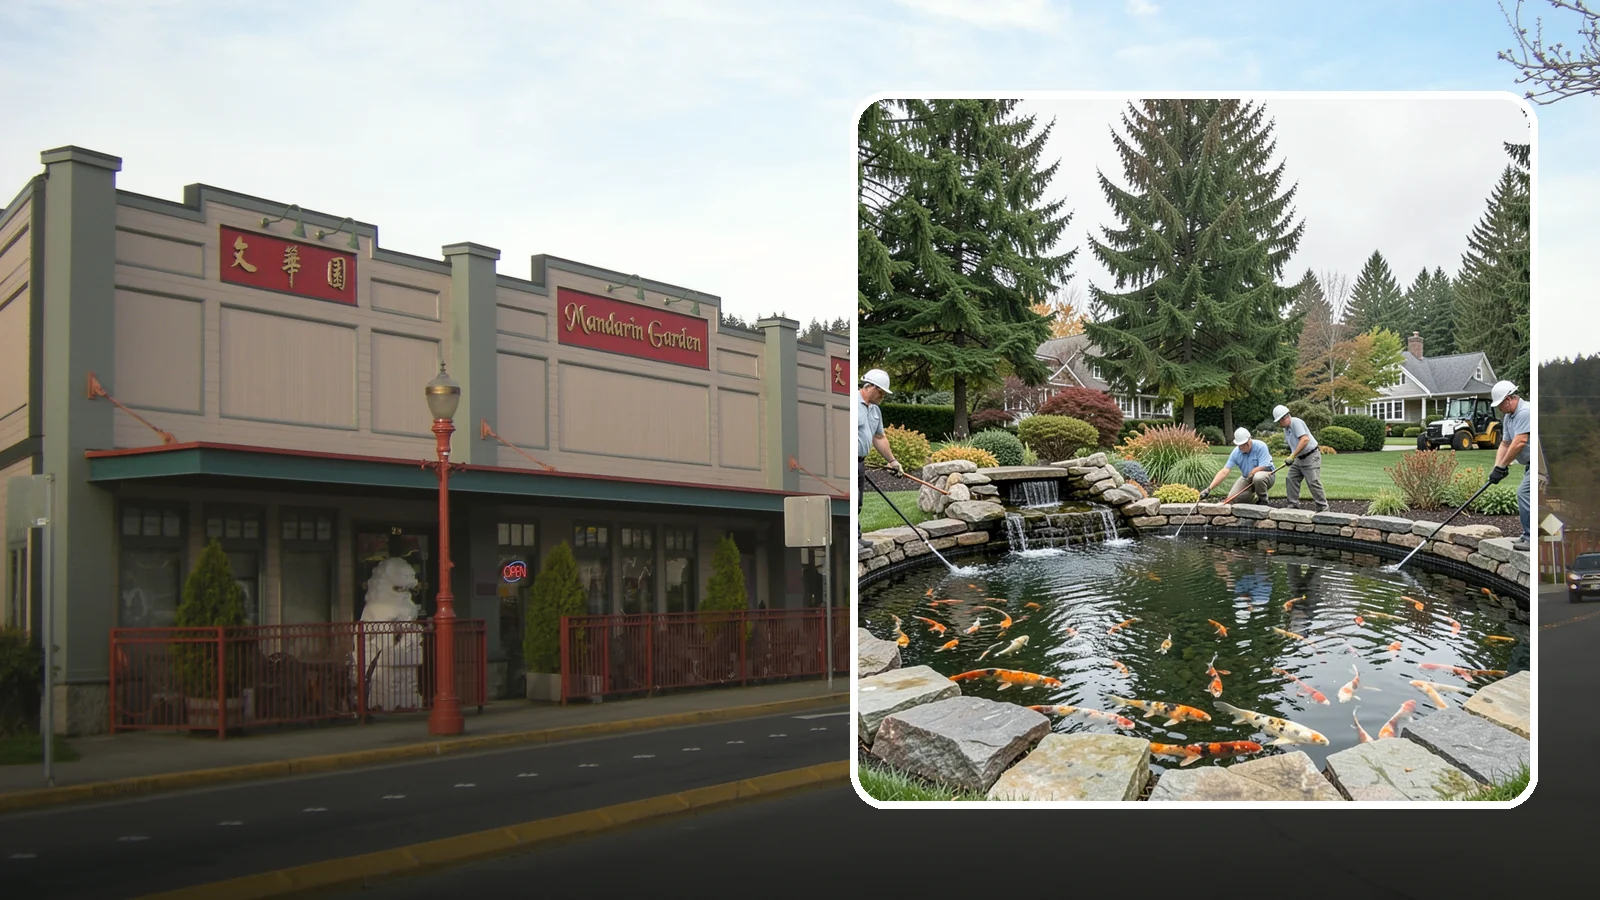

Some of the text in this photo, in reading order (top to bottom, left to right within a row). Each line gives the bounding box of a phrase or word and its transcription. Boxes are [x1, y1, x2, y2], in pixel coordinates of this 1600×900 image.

[231, 236, 346, 290] 文華園
[564, 302, 701, 352] Mandarin Garden
[503, 565, 527, 578] OPEN
